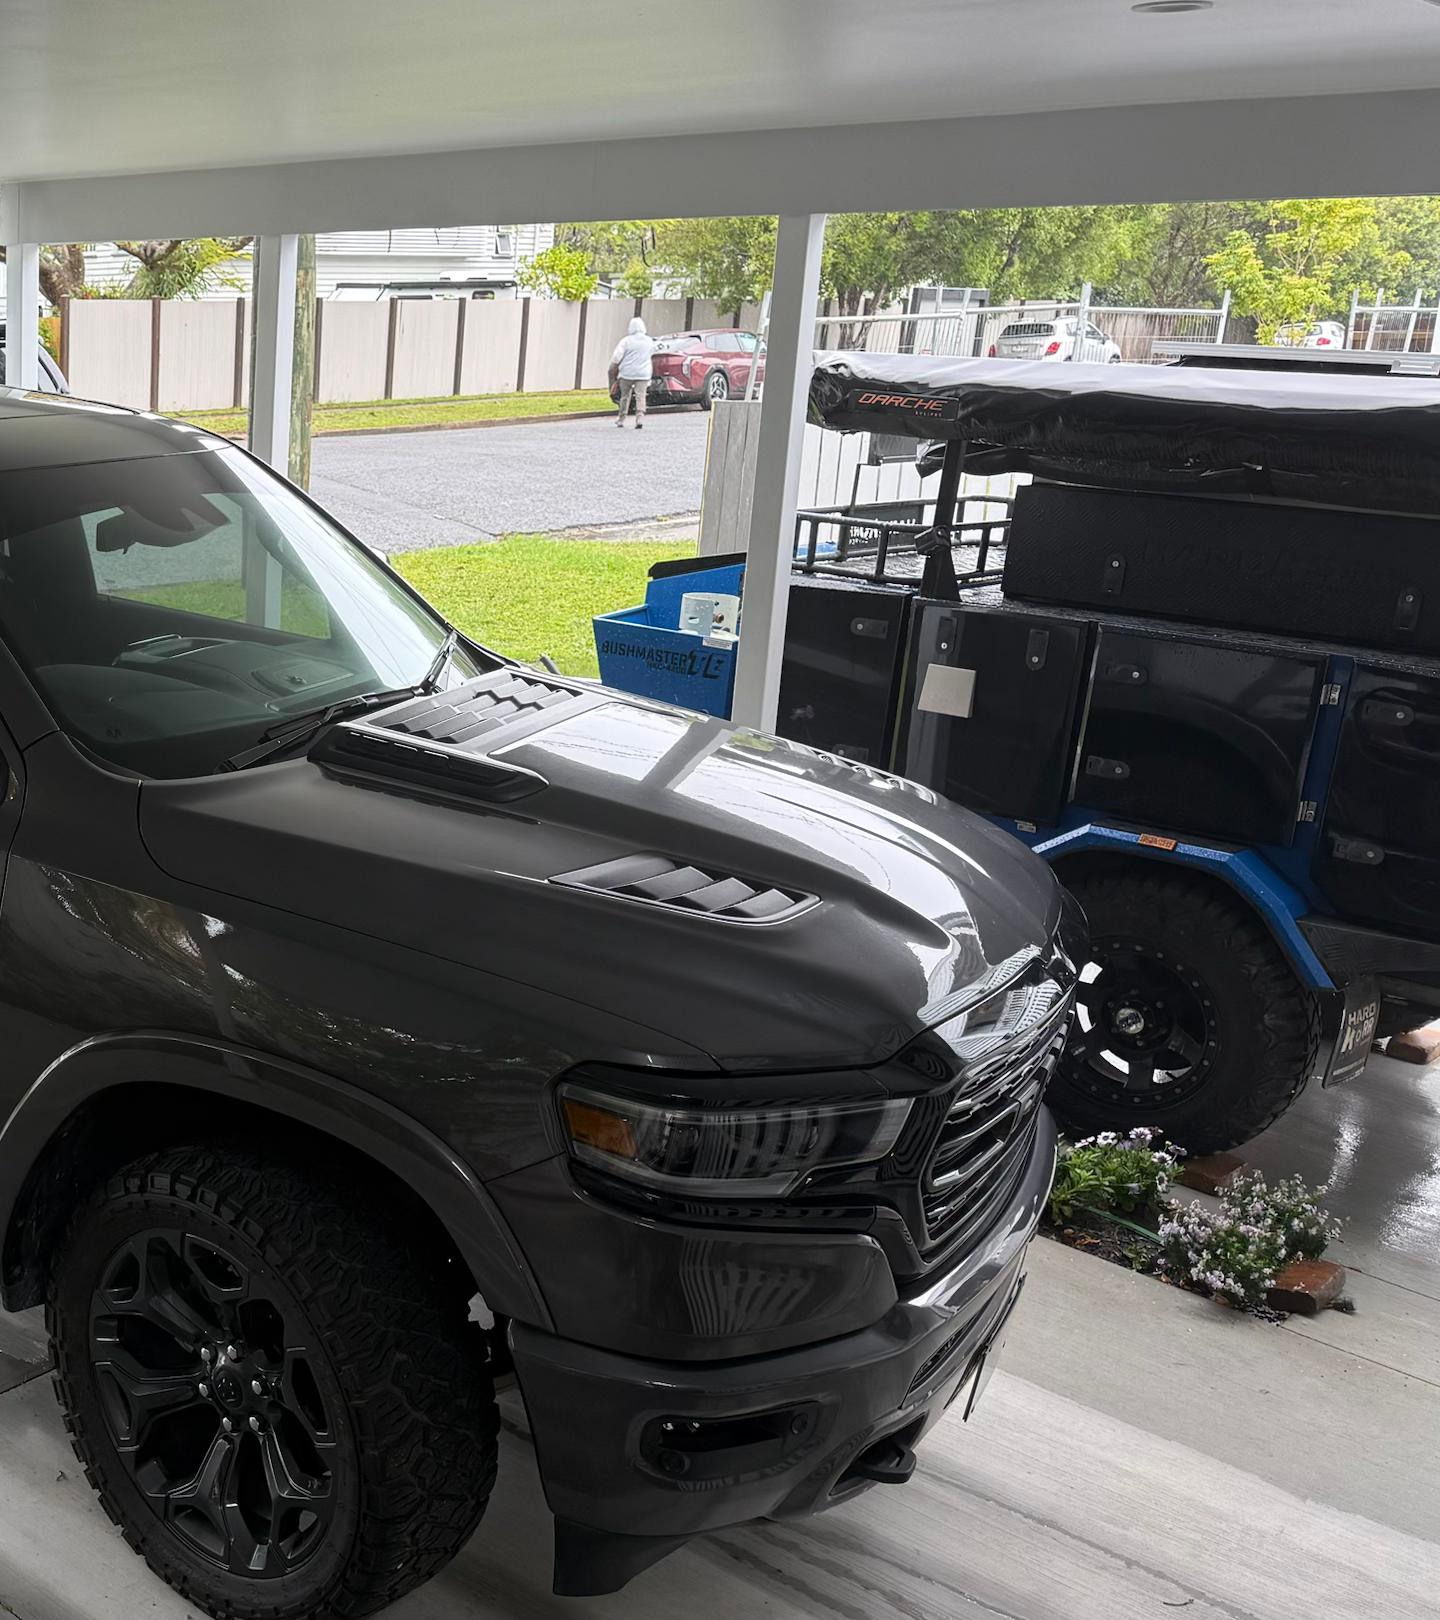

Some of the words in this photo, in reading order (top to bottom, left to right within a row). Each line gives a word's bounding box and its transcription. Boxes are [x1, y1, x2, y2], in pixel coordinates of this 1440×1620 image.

[858, 392, 948, 411] DARCHE
[602, 640, 688, 667] BUSHMASTER
[1348, 1003, 1376, 1025] HARD
